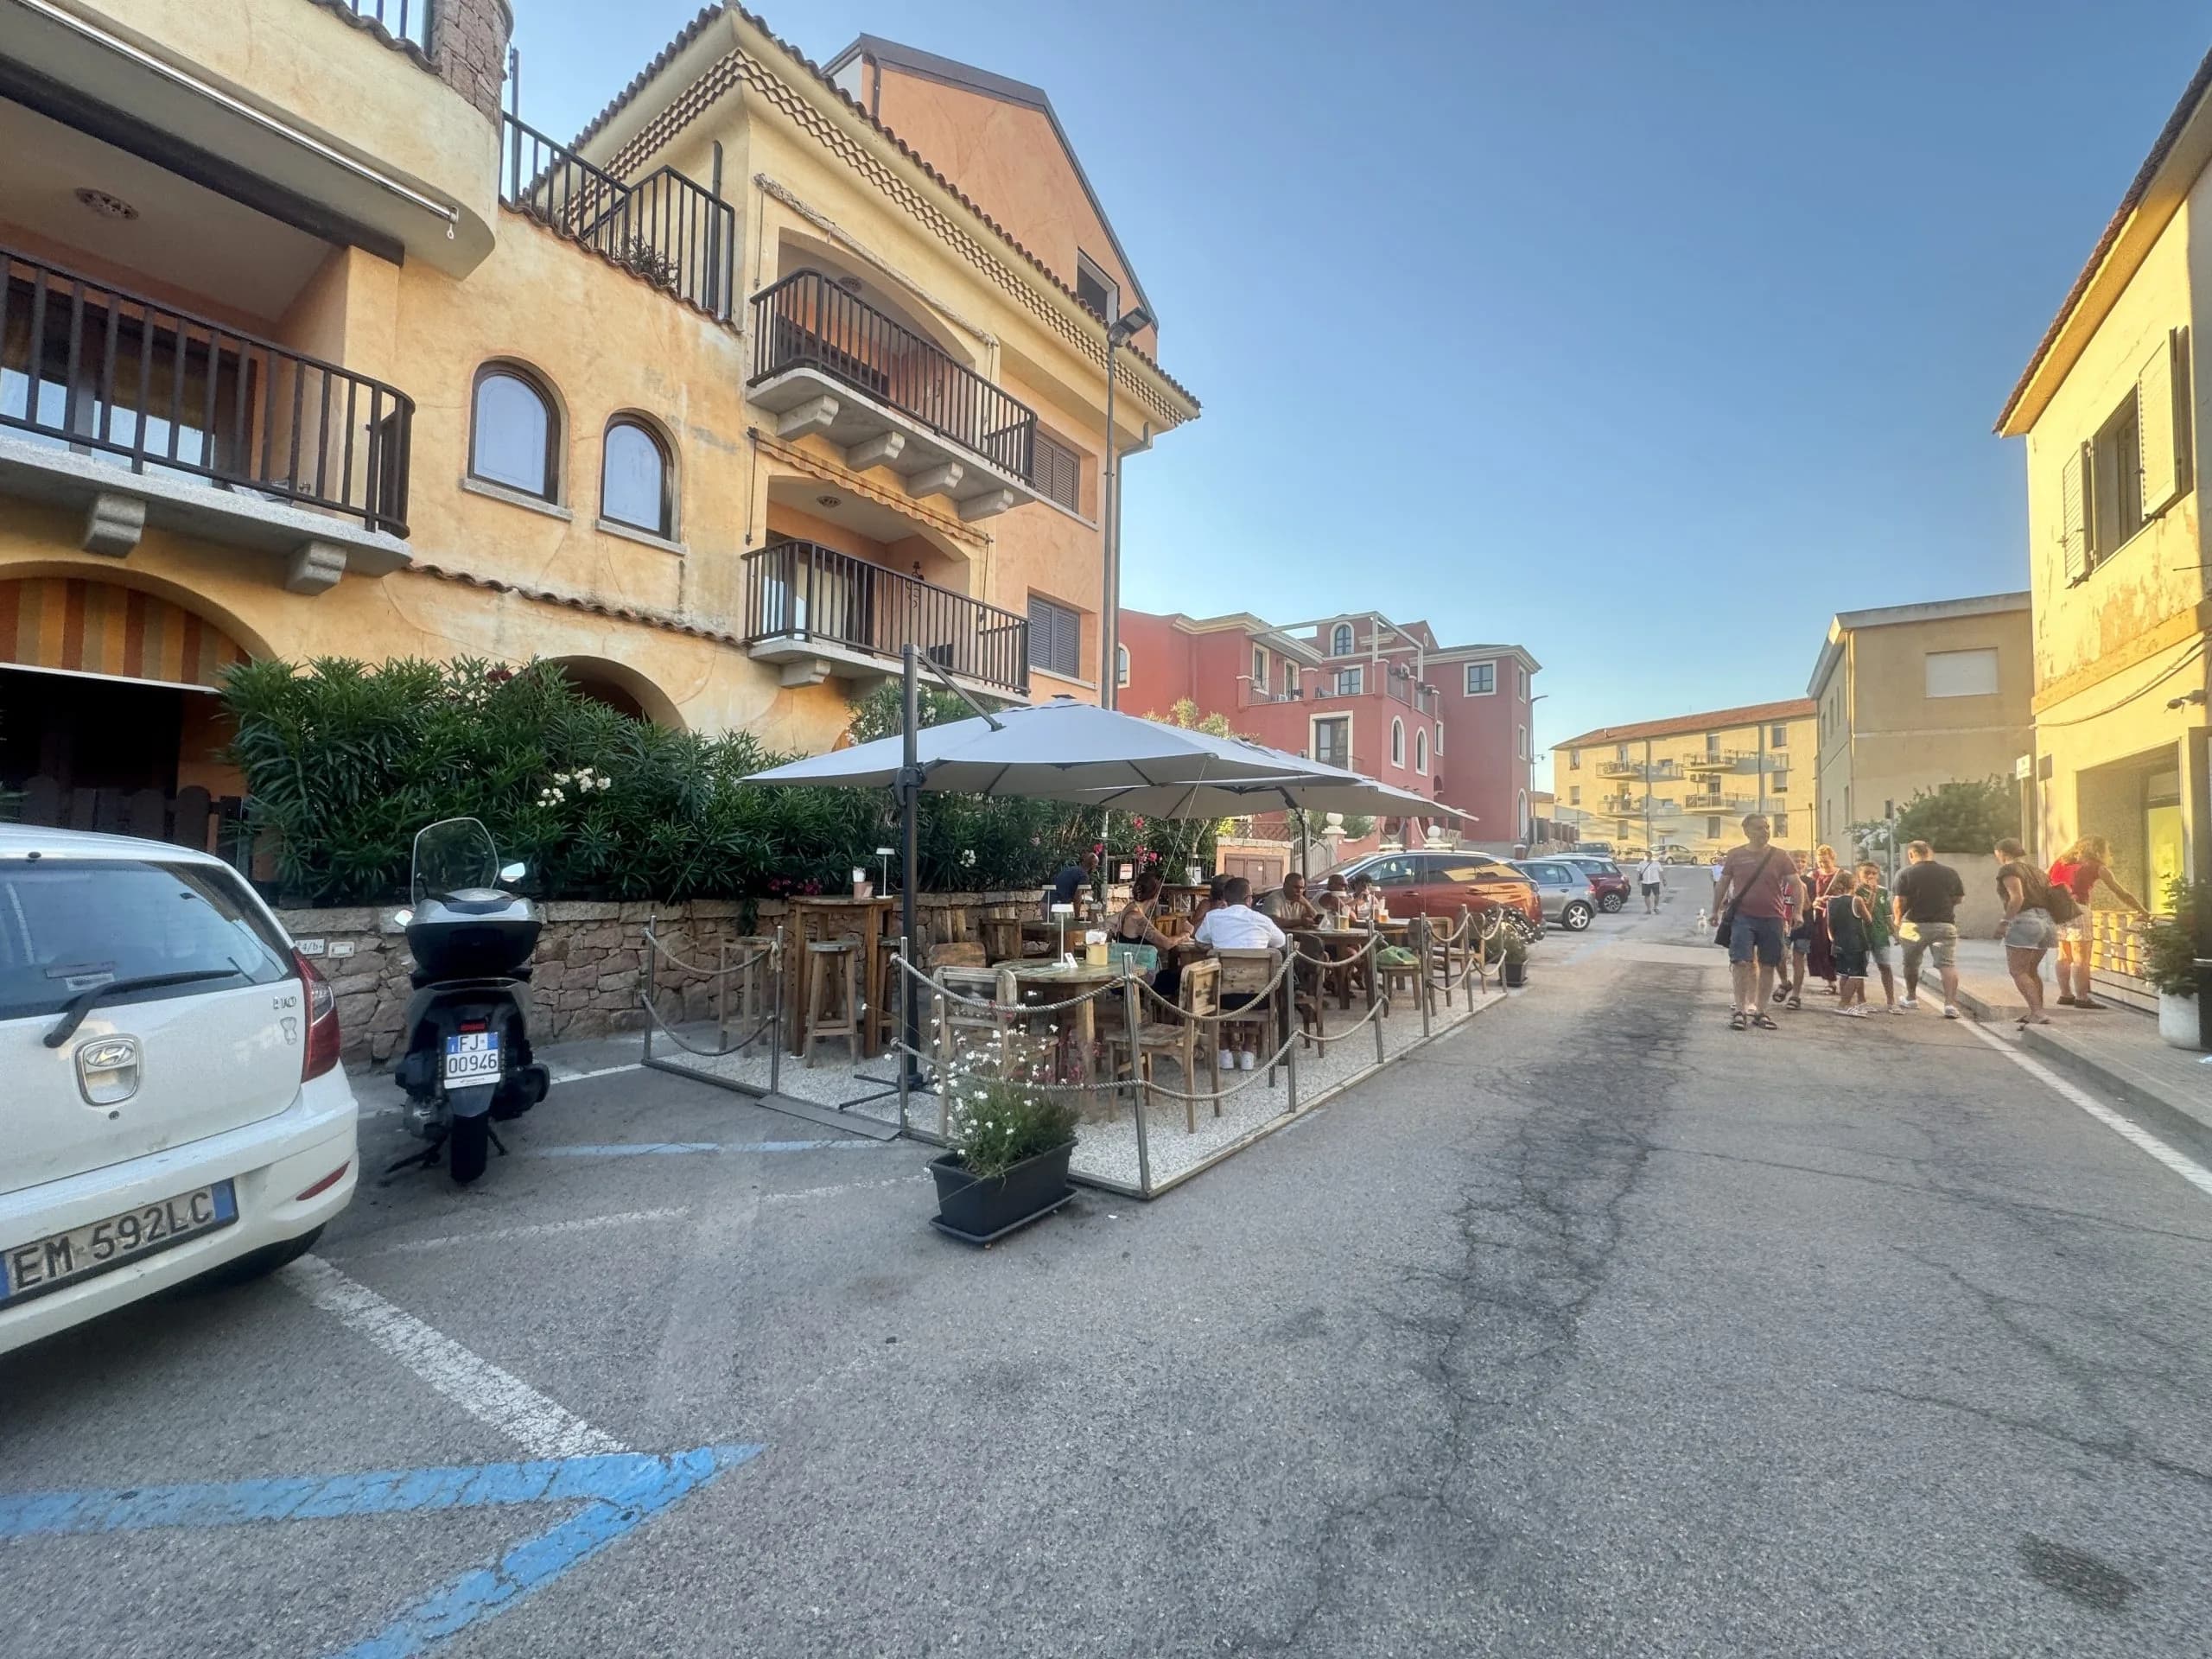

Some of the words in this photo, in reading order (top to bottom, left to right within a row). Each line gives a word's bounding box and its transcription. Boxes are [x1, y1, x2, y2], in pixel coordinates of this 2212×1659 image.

[460, 1035, 479, 1051] FJ
[448, 1053, 497, 1073] 00946
[14, 1236, 73, 1288] EM
[91, 1192, 211, 1260] 592LC
